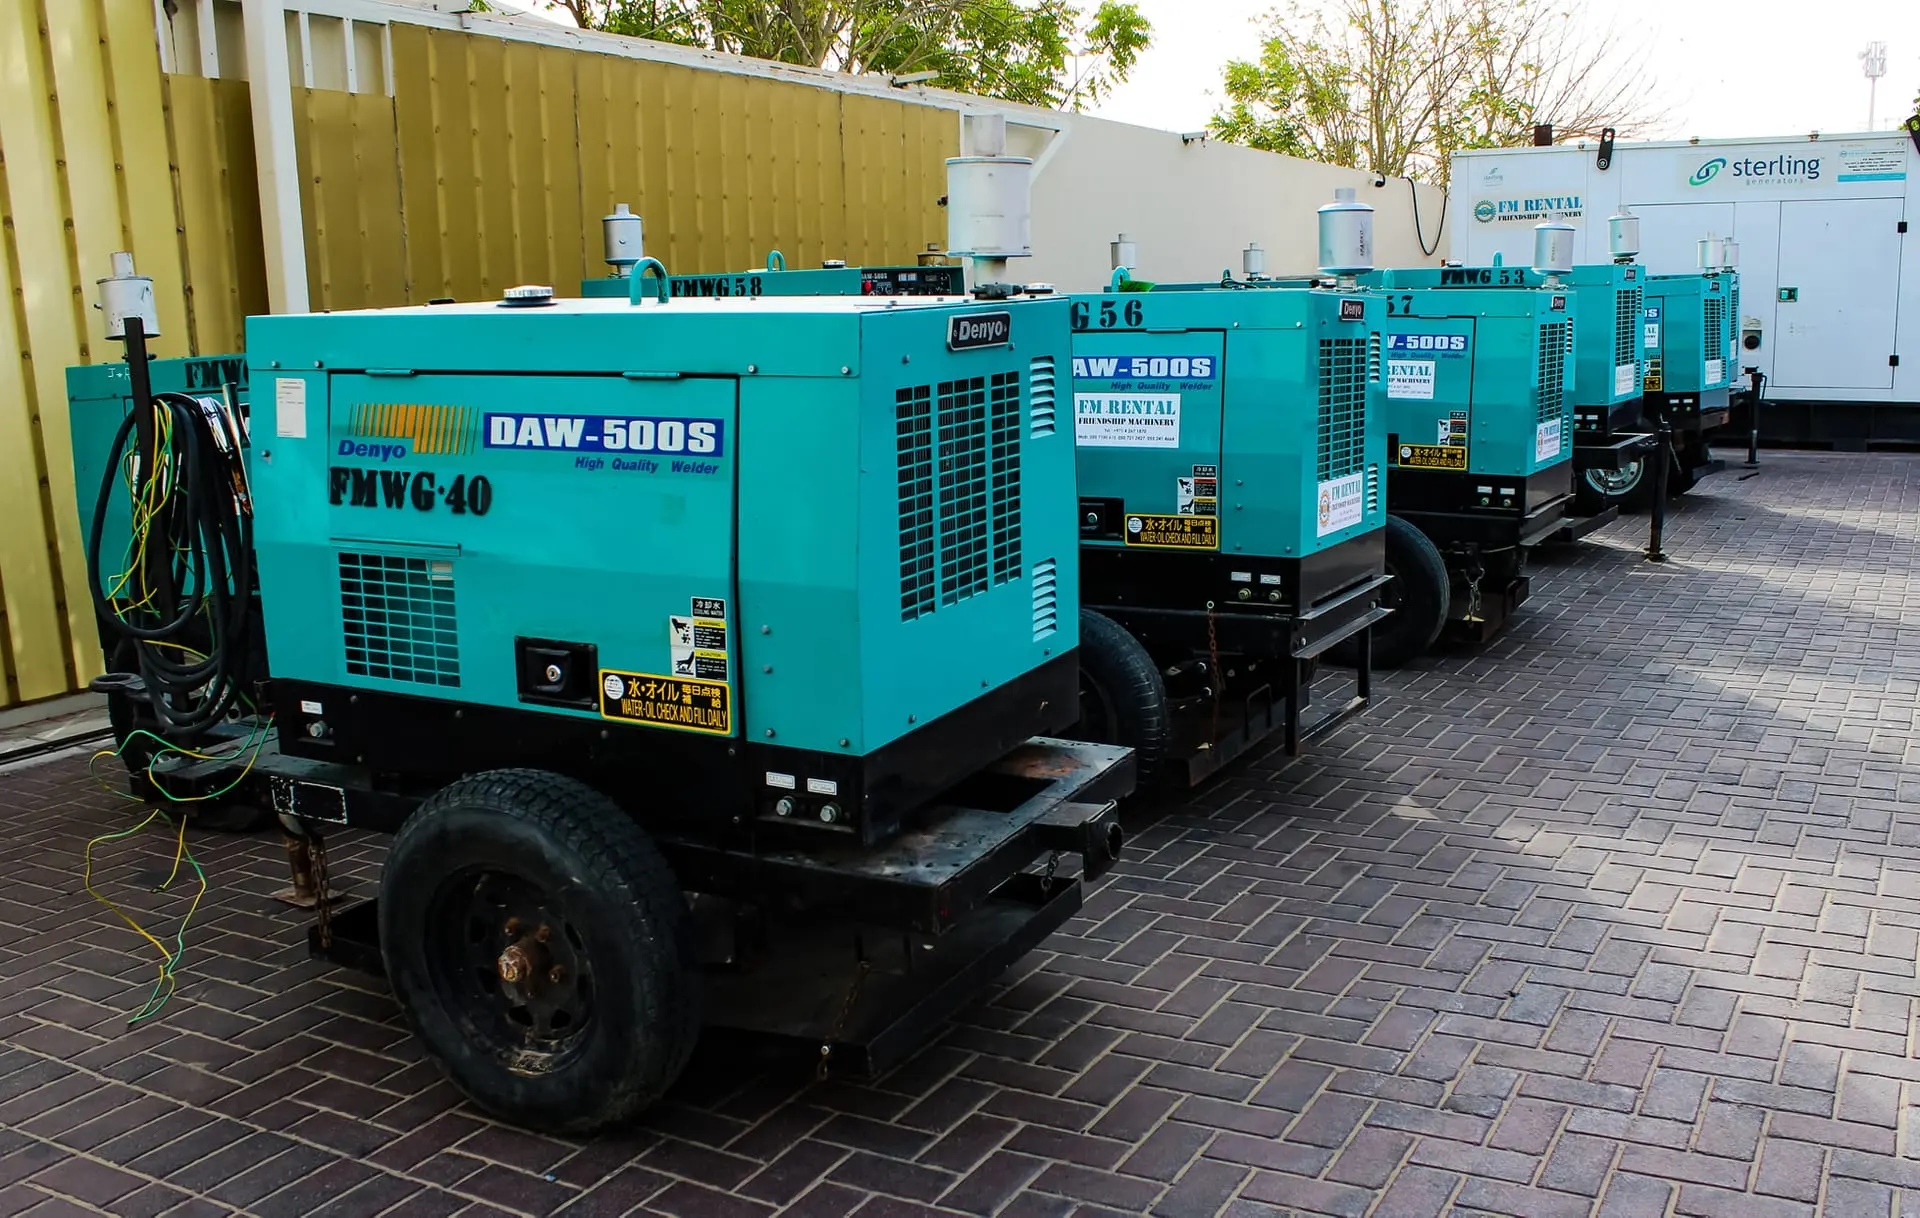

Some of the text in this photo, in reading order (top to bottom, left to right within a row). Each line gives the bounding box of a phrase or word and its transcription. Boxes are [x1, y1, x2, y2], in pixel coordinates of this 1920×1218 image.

[1733, 155, 1820, 180] sterling
[1746, 178, 1804, 186] generators
[1498, 196, 1583, 213] FM RENTAL
[1498, 213, 1540, 221] FRIENDSHIP
[1440, 269, 1491, 286] FMWG
[671, 277, 729, 297] FMWG
[1344, 302, 1362, 318] Denyo
[959, 320, 1003, 342] Denyo
[1110, 382, 1213, 391] High Quality Welder
[1079, 399, 1176, 415] FM RENTAL
[1078, 417, 1176, 426] FRIENDSHIP MACHINERY
[490, 416, 717, 453] DAW-500S
[338, 439, 407, 462] Denyo
[575, 456, 719, 476] High Quality Welder
[1165, 532, 1181, 544] CHECK
[1181, 533, 1192, 544] AND
[1192, 533, 1201, 545] FILL
[1201, 533, 1215, 545] DAILY
[656, 701, 679, 721] CHECK
[680, 705, 693, 723] AND
[694, 707, 708, 725] FILL
[708, 708, 727, 728] DAILY
